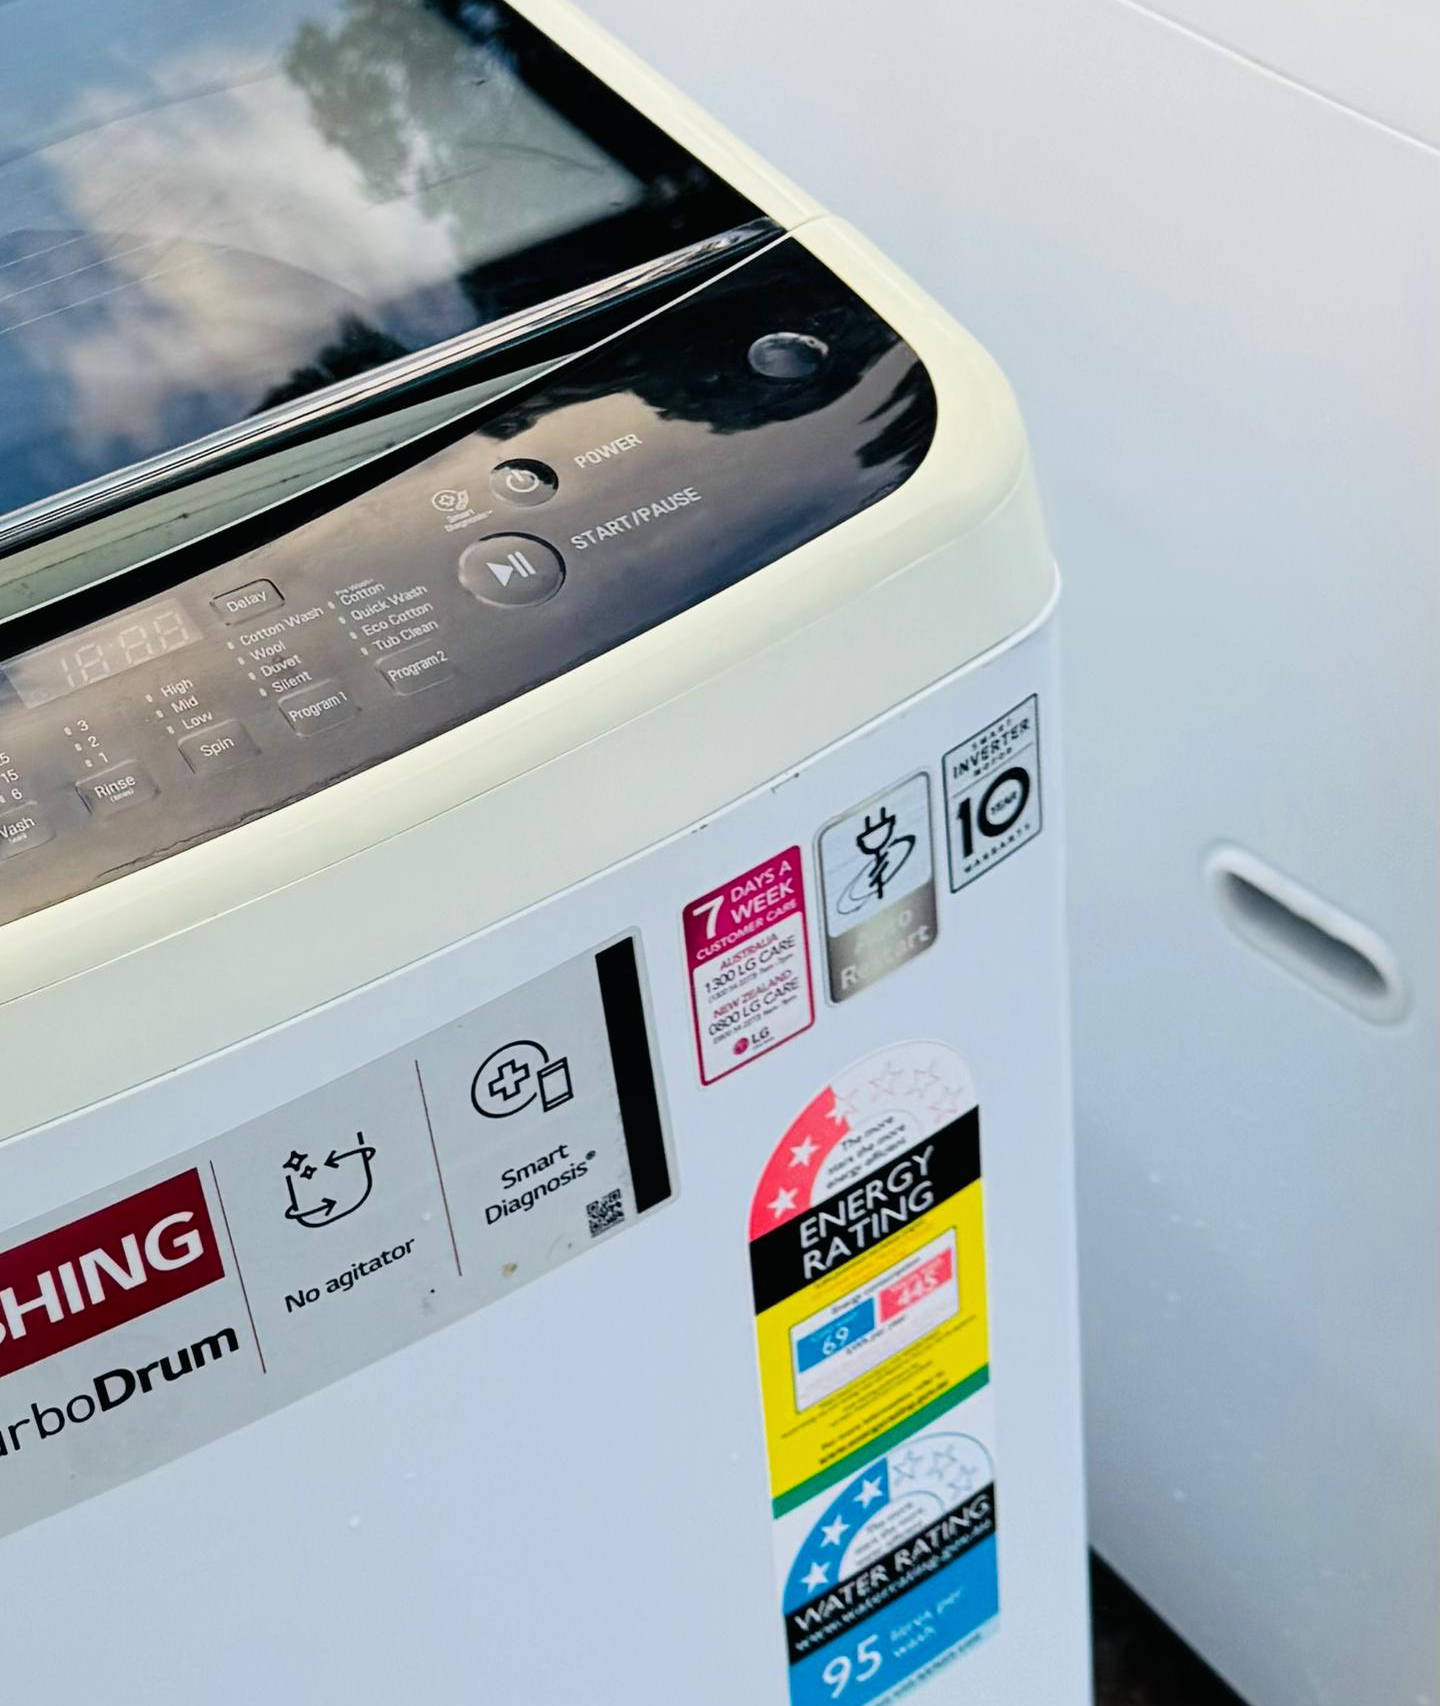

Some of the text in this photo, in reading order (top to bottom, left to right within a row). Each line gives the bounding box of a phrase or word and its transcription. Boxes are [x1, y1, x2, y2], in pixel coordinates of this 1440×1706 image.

[573, 432, 643, 469] POWER
[570, 486, 703, 551] START/PAUSE
[226, 590, 267, 613] Delay
[340, 582, 386, 606] Cotton
[350, 599, 389, 622] Quick
[387, 584, 428, 606] Wash
[239, 606, 325, 647] Cotton Wash
[361, 600, 434, 637] Eco Cotton
[371, 618, 440, 652] Tub Clean
[249, 641, 287, 662] Wool
[260, 654, 302, 678] Duvet
[388, 649, 449, 684] Program 2
[160, 678, 194, 699] High
[271, 671, 313, 694] Silent
[171, 694, 199, 714] Mid
[181, 710, 214, 731] Low
[287, 690, 349, 723] Program 1
[77, 719, 89, 733] 3
[88, 735, 100, 748] 2
[98, 752, 109, 764] 1
[200, 736, 235, 758] Spin
[953, 718, 1030, 780] INVERTER
[0, 769, 20, 784] 15
[11, 788, 24, 801] 6
[94, 774, 137, 799] Rinse
[956, 766, 1030, 859] 10
[730, 859, 792, 904] DAYS A
[692, 895, 725, 940] 7
[730, 877, 794, 924] WEEK
[696, 898, 797, 961] CUSTOMER CARE
[705, 969, 736, 993] 1300
[738, 957, 756, 975] LG
[759, 934, 796, 964] CARE
[841, 924, 930, 990] Reart
[708, 1011, 740, 1036] 0800
[743, 999, 761, 1018] LG
[763, 976, 800, 1005] CARE
[751, 1026, 770, 1044] LG
[501, 1143, 570, 1190] Smart
[799, 1145, 935, 1249] ENERGY
[803, 1181, 935, 1280] RATING
[284, 1237, 416, 1313] No agitator
[822, 1326, 849, 1356] 69
[794, 1563, 891, 1632] WATER
[893, 1494, 992, 1574] RATING
[822, 1633, 882, 1699] 95
